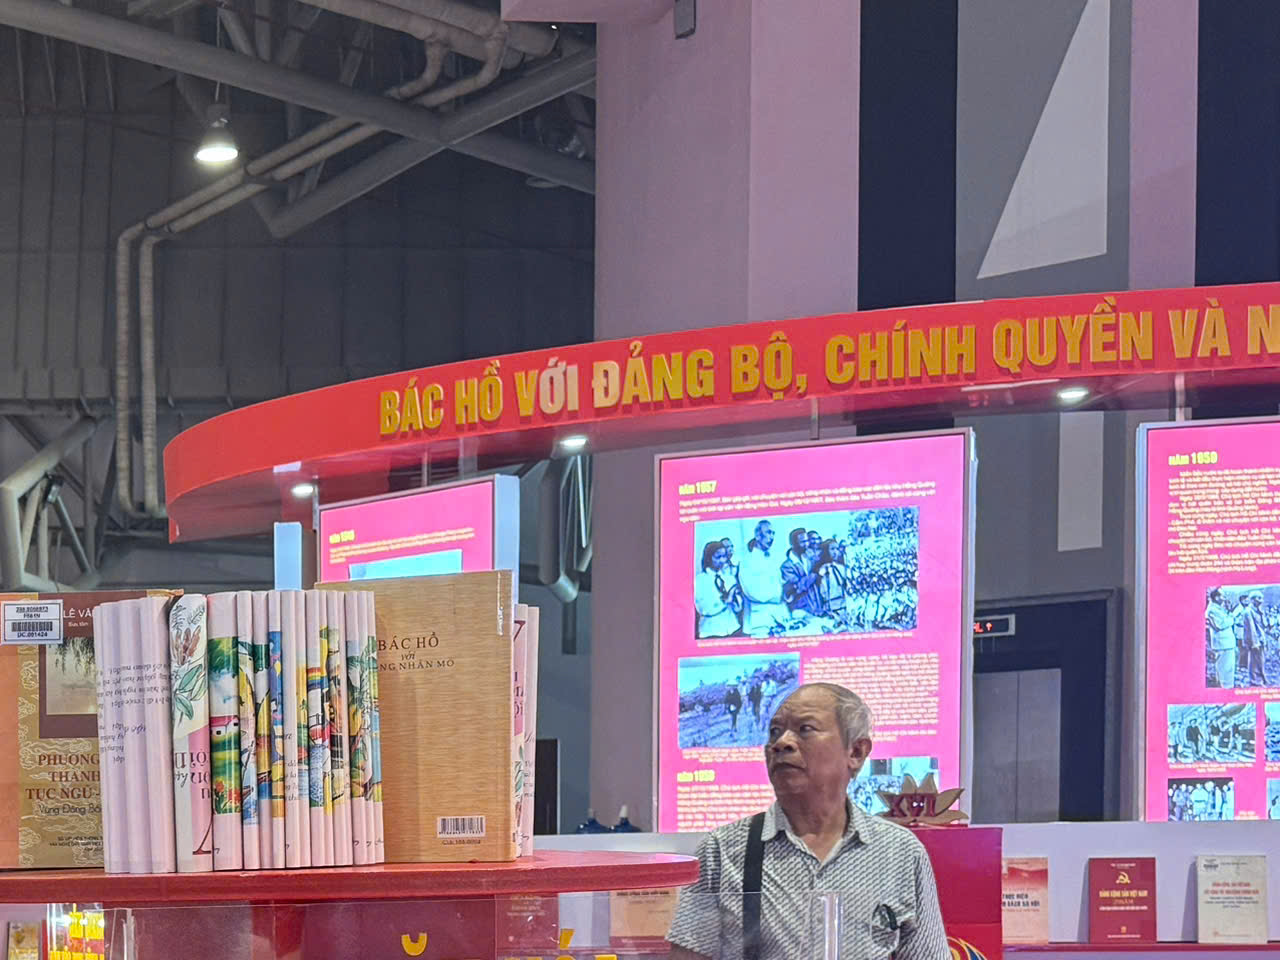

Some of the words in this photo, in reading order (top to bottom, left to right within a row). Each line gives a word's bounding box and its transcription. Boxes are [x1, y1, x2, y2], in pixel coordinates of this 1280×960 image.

[380, 376, 443, 435] BÁC
[455, 360, 503, 425] HỒ
[514, 356, 578, 417] VỚI
[592, 340, 714, 409] ĐẢNG
[731, 331, 807, 399] BỘ,
[825, 320, 976, 384] CHÍNH
[993, 296, 1152, 374] QUYỀN
[1169, 298, 1230, 358] VÀ
[79, 607, 93, 618] VĂ
[378, 635, 411, 651] BÁC
[416, 632, 440, 648] HỒ
